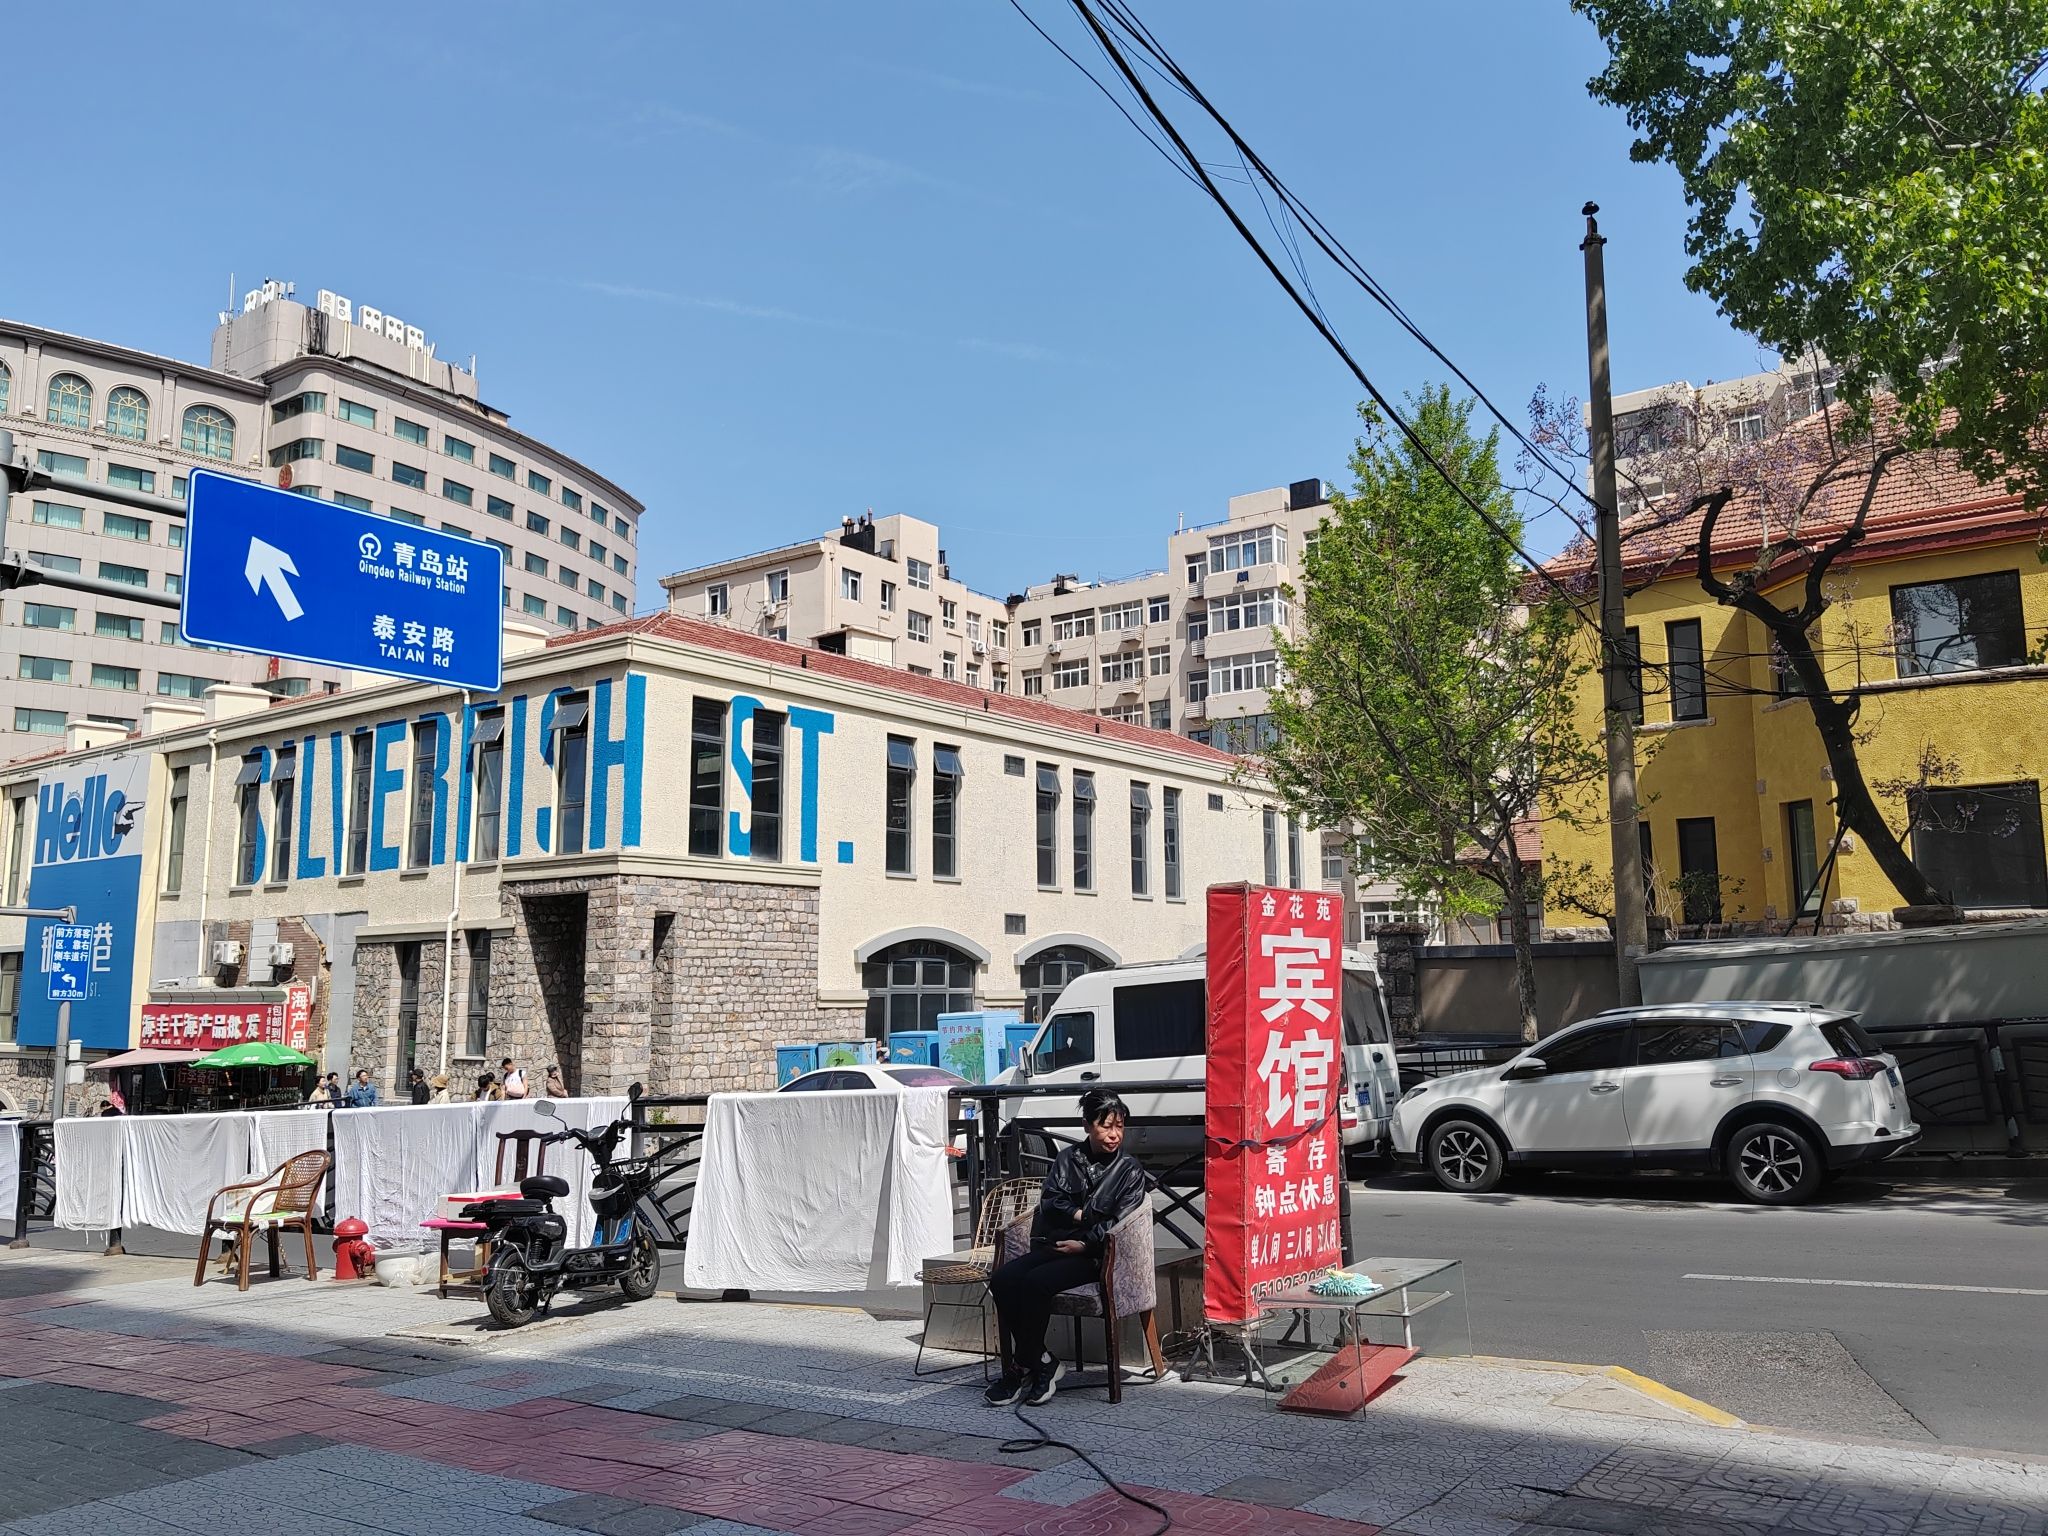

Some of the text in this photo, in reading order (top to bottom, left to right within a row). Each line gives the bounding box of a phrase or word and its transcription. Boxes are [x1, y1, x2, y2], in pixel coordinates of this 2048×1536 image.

[359, 560, 466, 594] Qingdao Railway Station
[393, 541, 469, 582] 青岛站
[372, 614, 455, 653] 泰安路
[433, 654, 450, 668] Rd
[246, 674, 647, 884] SLVERFISH
[34, 773, 126, 865] Hello
[1260, 891, 1331, 921] 金花苑
[56, 927, 91, 939] 前方落客
[54, 951, 88, 962] 侧车道行
[290, 990, 309, 1050] 海产品
[1257, 927, 1334, 1129] 宾馆
[1265, 1137, 1328, 1177] 寄存
[1255, 1173, 1336, 1218] 钟点休息
[1250, 1231, 1281, 1269] 单人间
[1285, 1225, 1313, 1260] 三人间
